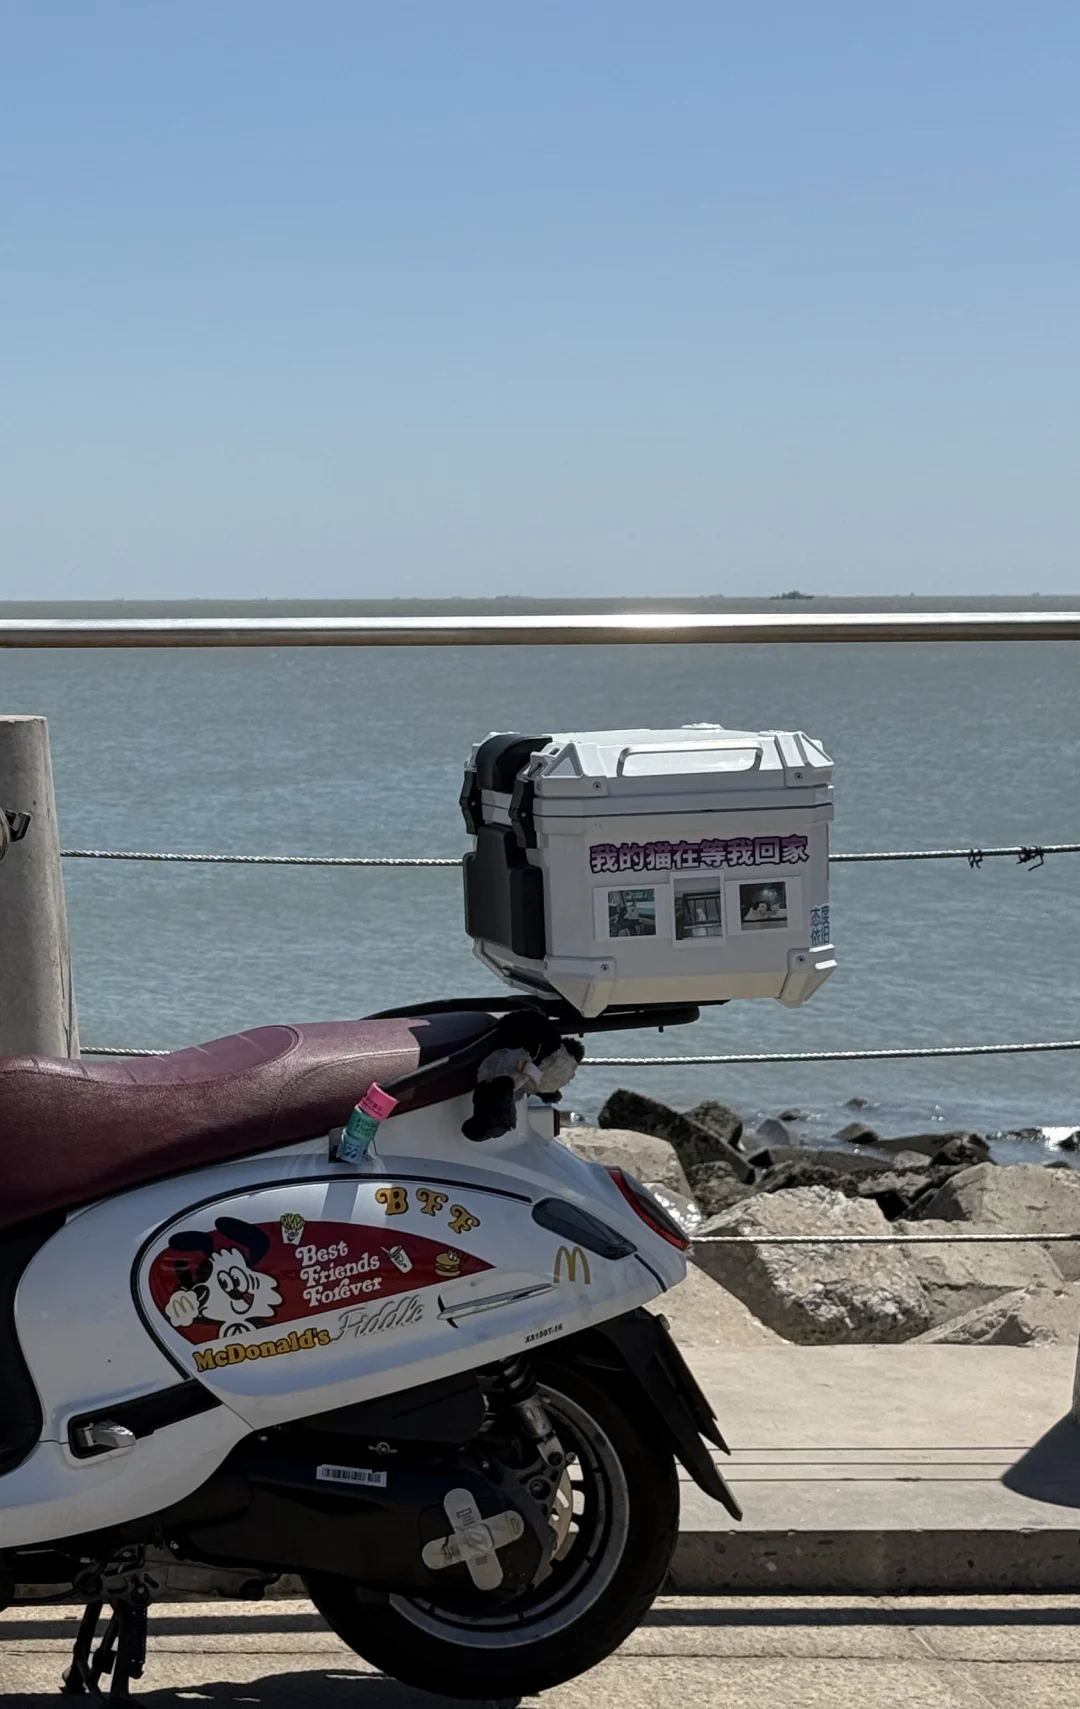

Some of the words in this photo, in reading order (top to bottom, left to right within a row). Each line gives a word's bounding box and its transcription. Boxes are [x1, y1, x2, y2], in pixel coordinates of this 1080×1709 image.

[590, 834, 810, 873] 我的猫在等我回家
[810, 905, 830, 926] 态度
[810, 926, 830, 946] 依旧
[295, 1240, 349, 1267] Best
[300, 1253, 380, 1288] Friends
[553, 1245, 591, 1285] M
[303, 1275, 383, 1307] Forever
[330, 1294, 425, 1342] Fiddle
[192, 1327, 331, 1372] McDonald's
